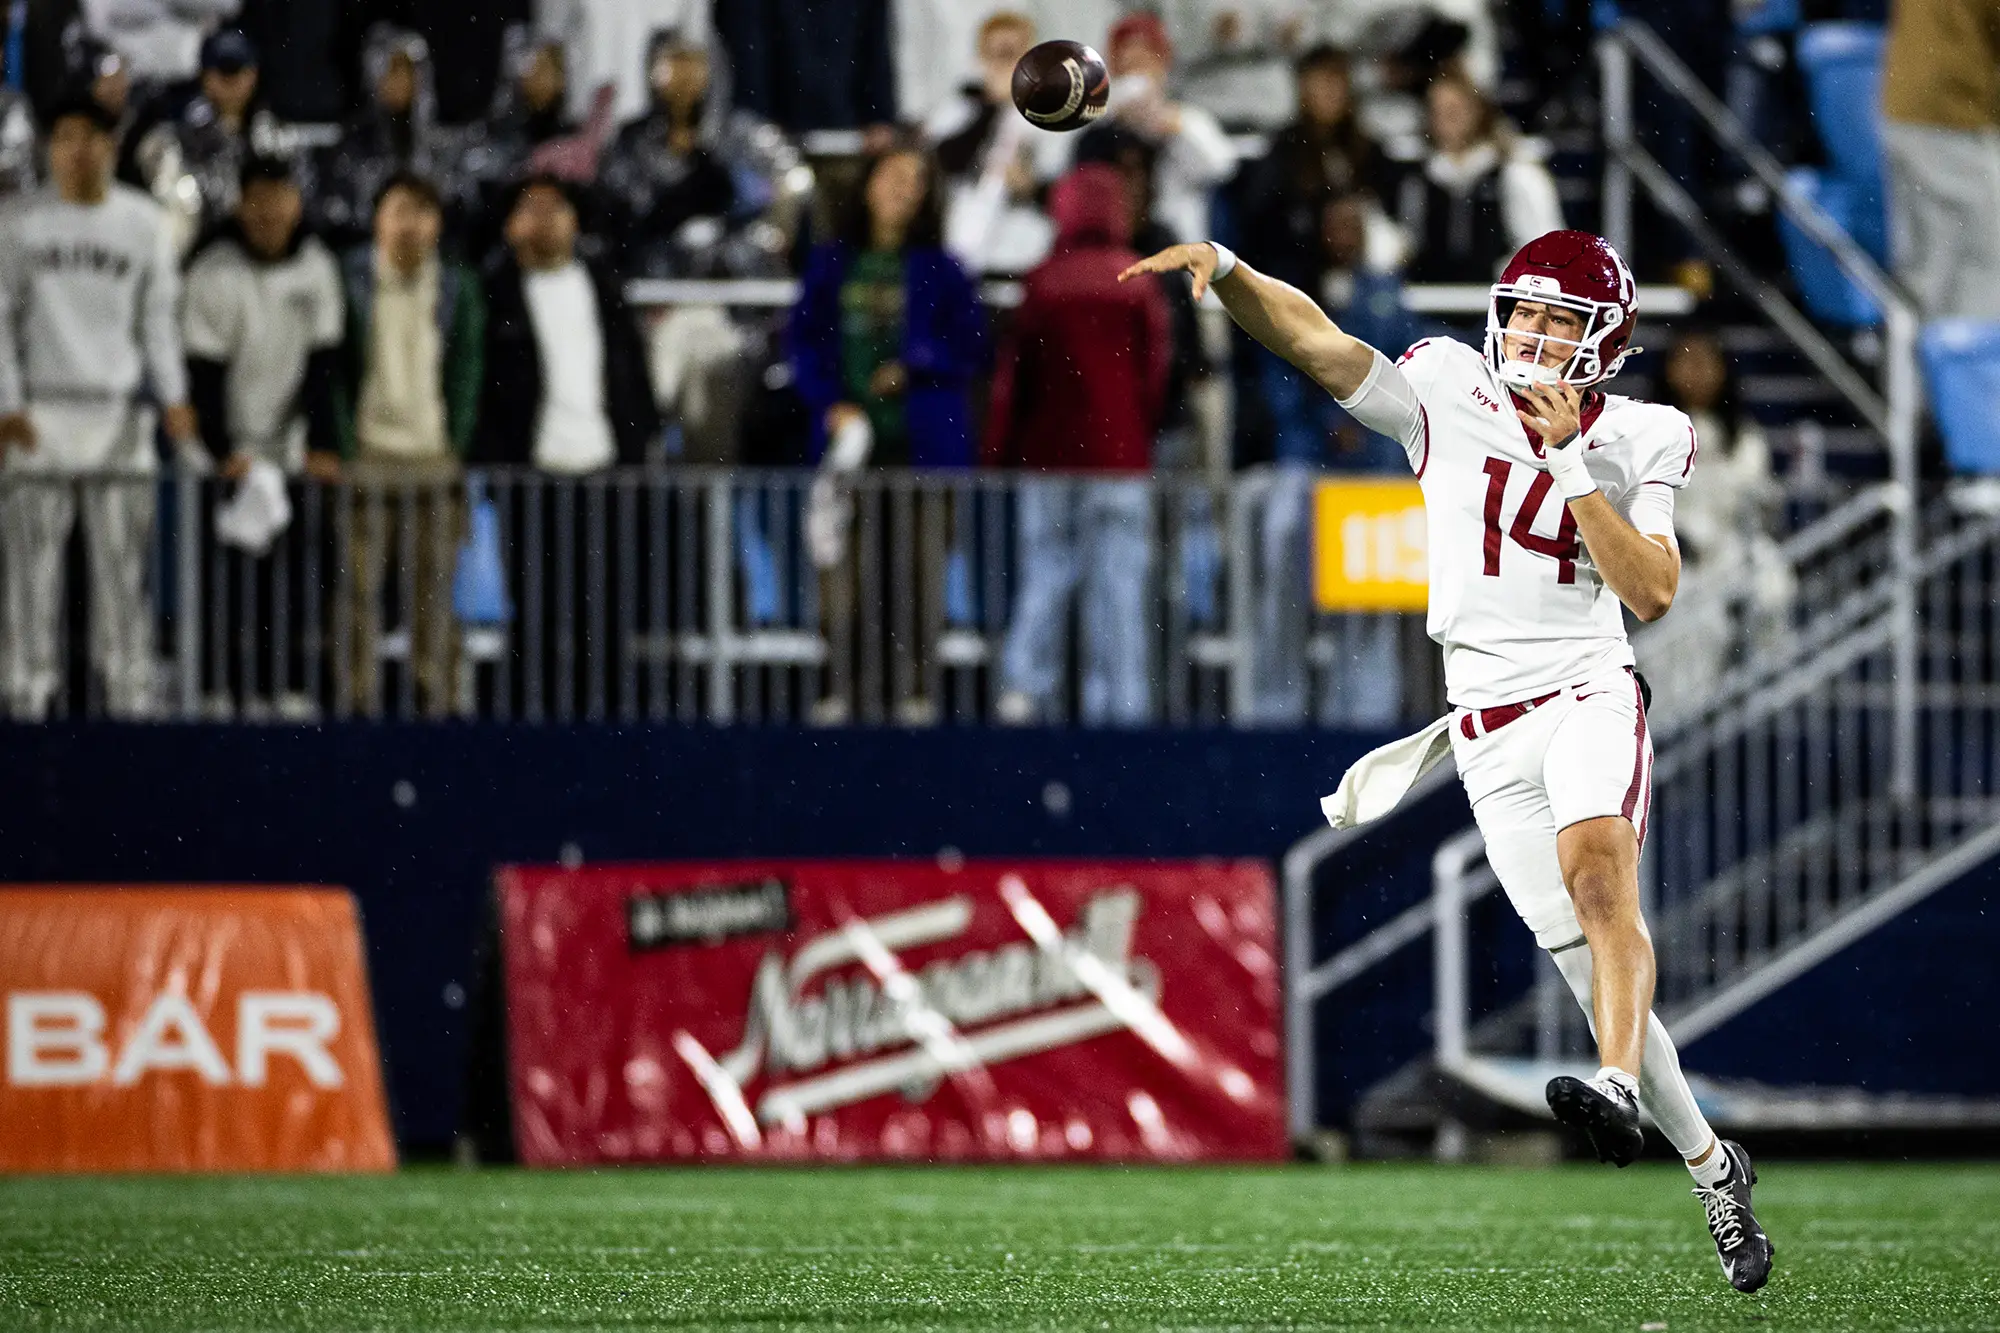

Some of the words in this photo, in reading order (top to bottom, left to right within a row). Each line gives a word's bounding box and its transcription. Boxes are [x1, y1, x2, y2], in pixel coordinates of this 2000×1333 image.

[1471, 386, 1491, 406] Ivy
[1483, 456, 1580, 585] 14
[8, 990, 345, 1088] BAR
